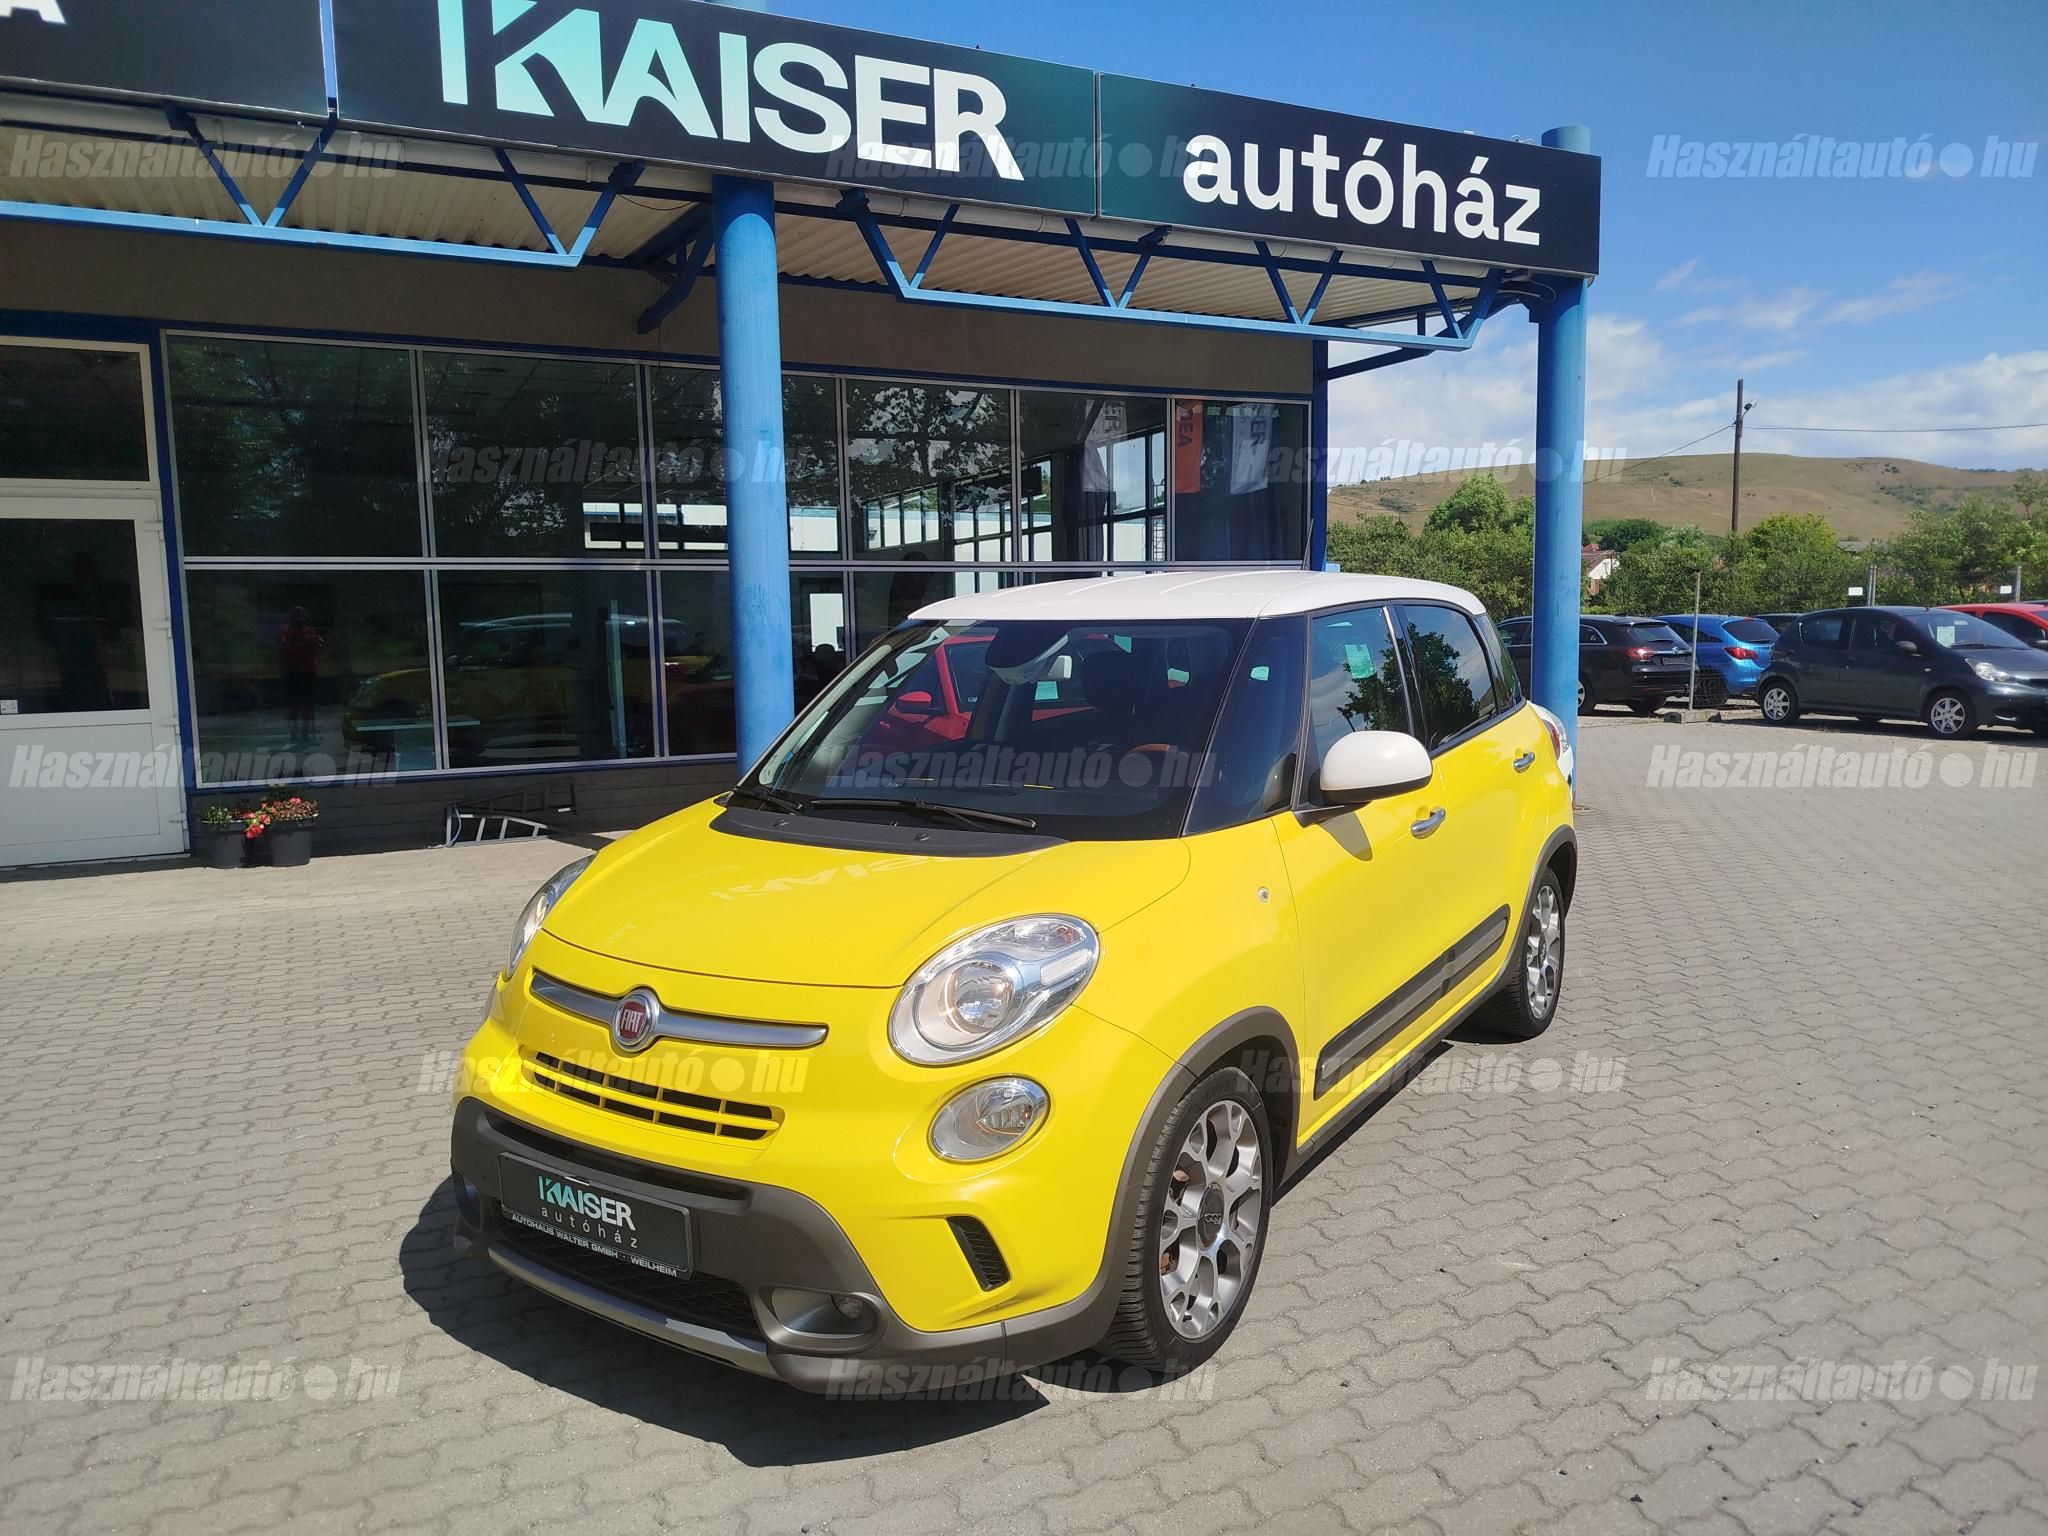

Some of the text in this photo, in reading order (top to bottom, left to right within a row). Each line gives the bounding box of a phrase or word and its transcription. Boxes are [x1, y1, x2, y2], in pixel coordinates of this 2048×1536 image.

[437, 0, 1541, 246] KAISER autóház
[620, 1008, 644, 1033] FIAT
[538, 1175, 637, 1231] KAISER
[511, 1213, 677, 1278] AUTOHAUS WALTER GMBH WEILHEIM
